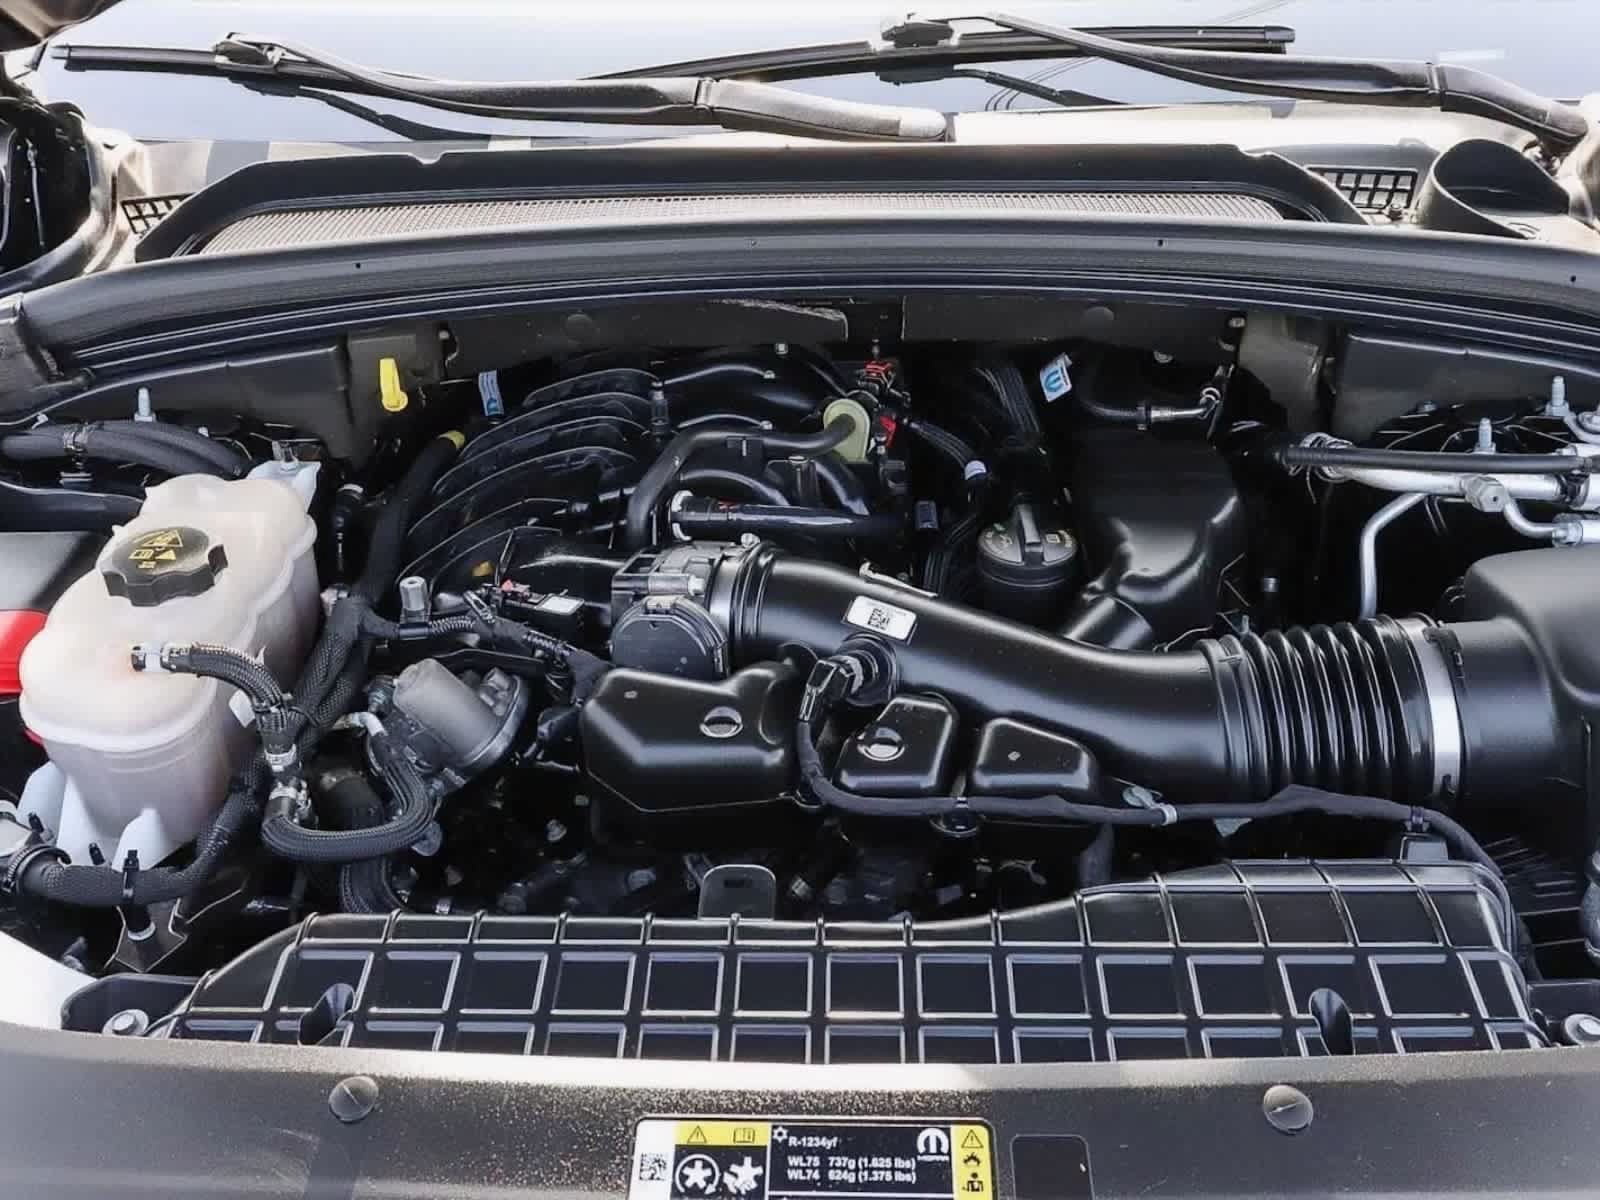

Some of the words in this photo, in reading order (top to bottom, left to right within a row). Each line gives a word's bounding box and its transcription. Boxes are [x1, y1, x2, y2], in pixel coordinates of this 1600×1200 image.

[788, 1136, 838, 1149] R-1234yf
[788, 1156, 820, 1167] WL75
[828, 1156, 856, 1169] 737g
[894, 1157, 916, 1170] lbs)
[787, 1169, 820, 1180] WL74
[828, 1170, 856, 1183] 624g
[858, 1170, 893, 1183] (1.375
[894, 1171, 916, 1184] lbs)
